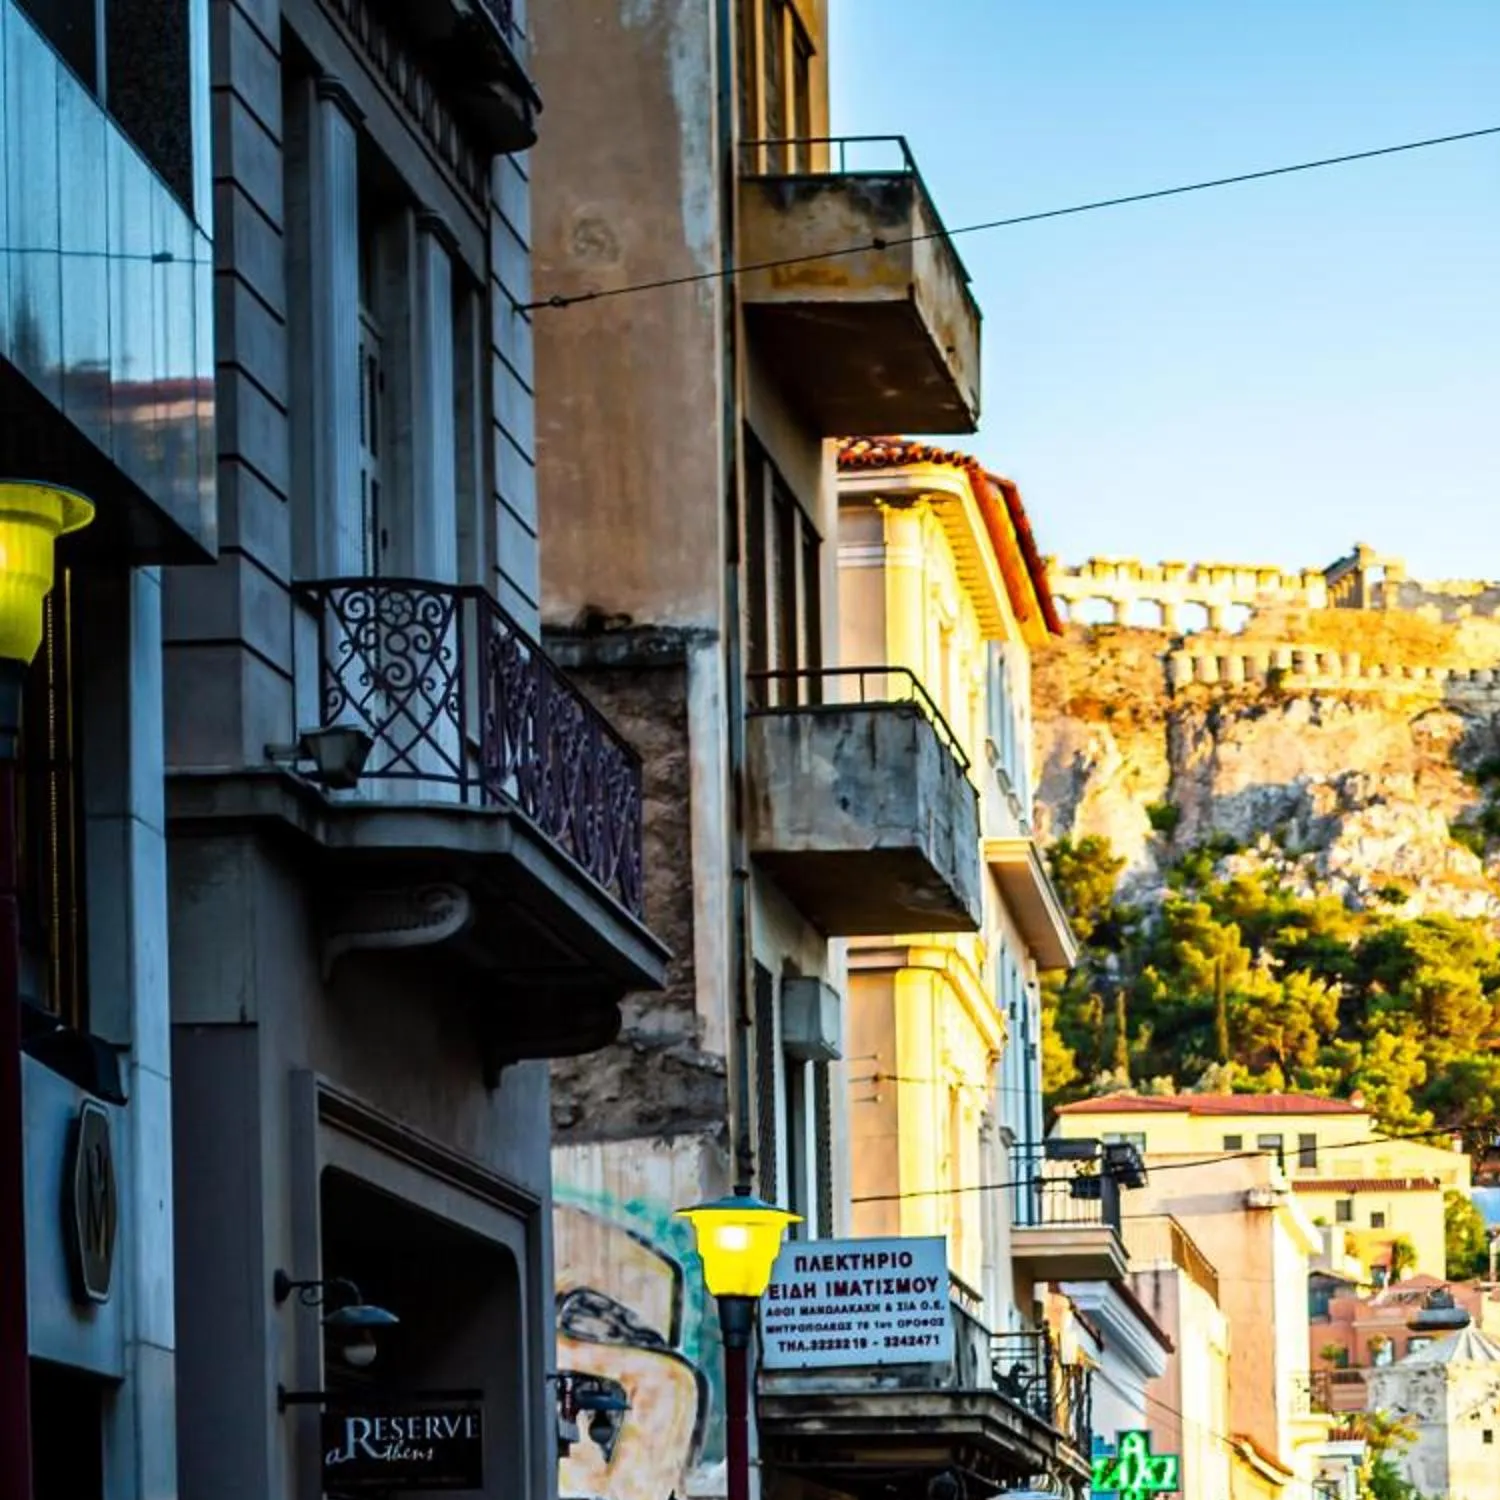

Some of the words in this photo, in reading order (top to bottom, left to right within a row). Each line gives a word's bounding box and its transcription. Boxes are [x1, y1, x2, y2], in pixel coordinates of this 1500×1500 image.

[794, 1251, 913, 1273] ΠΛΕΚΤΗΡΙΟ
[768, 1282, 817, 1300] ΕΙΔΗ
[826, 1276, 939, 1297] ΙΜΑΤΙΣΜΟΥ
[345, 1415, 480, 1459] RESERVE
